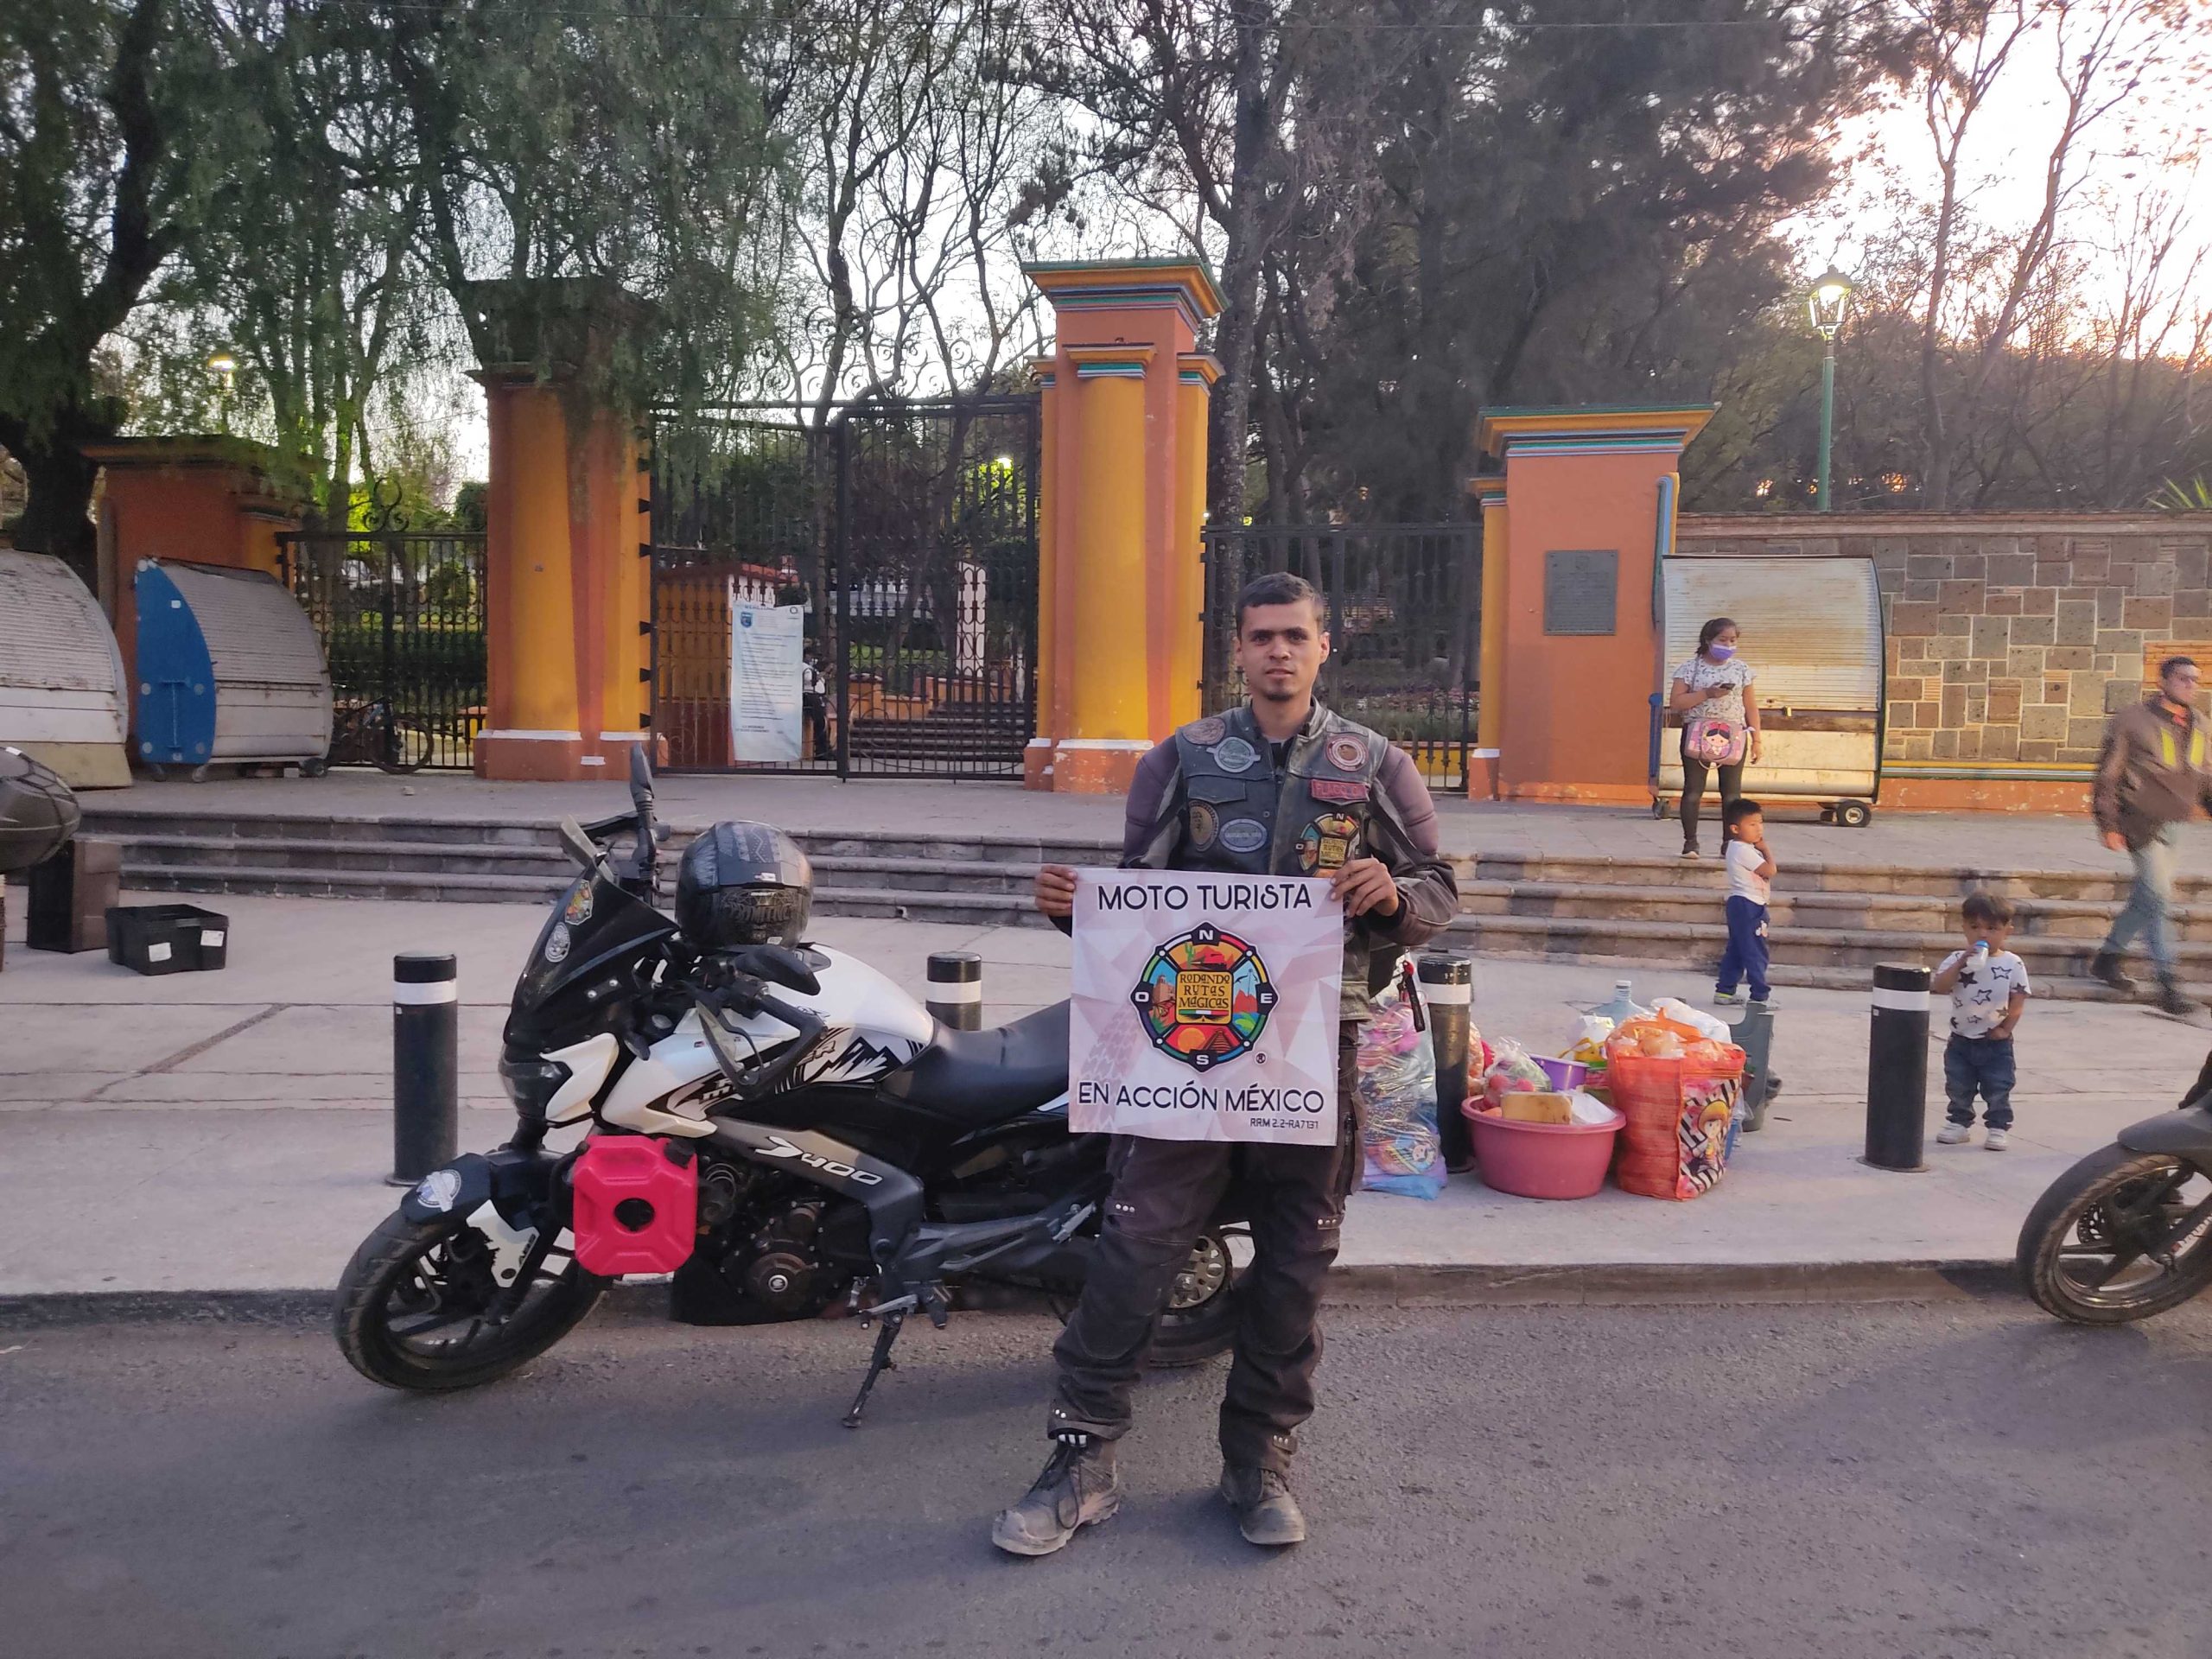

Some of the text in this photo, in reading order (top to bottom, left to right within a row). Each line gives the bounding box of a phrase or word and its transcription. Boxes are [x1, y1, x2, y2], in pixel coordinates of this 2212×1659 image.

[1097, 883, 1313, 910] MOTO TURISTA
[1198, 929, 1214, 941] N
[1135, 991, 1150, 1002] O
[1260, 993, 1273, 1004] E
[1196, 1054, 1210, 1065] S
[1078, 1079, 1325, 1114] EN ACCIÓN MÉXICO
[1249, 1117, 1271, 1128] RRM
